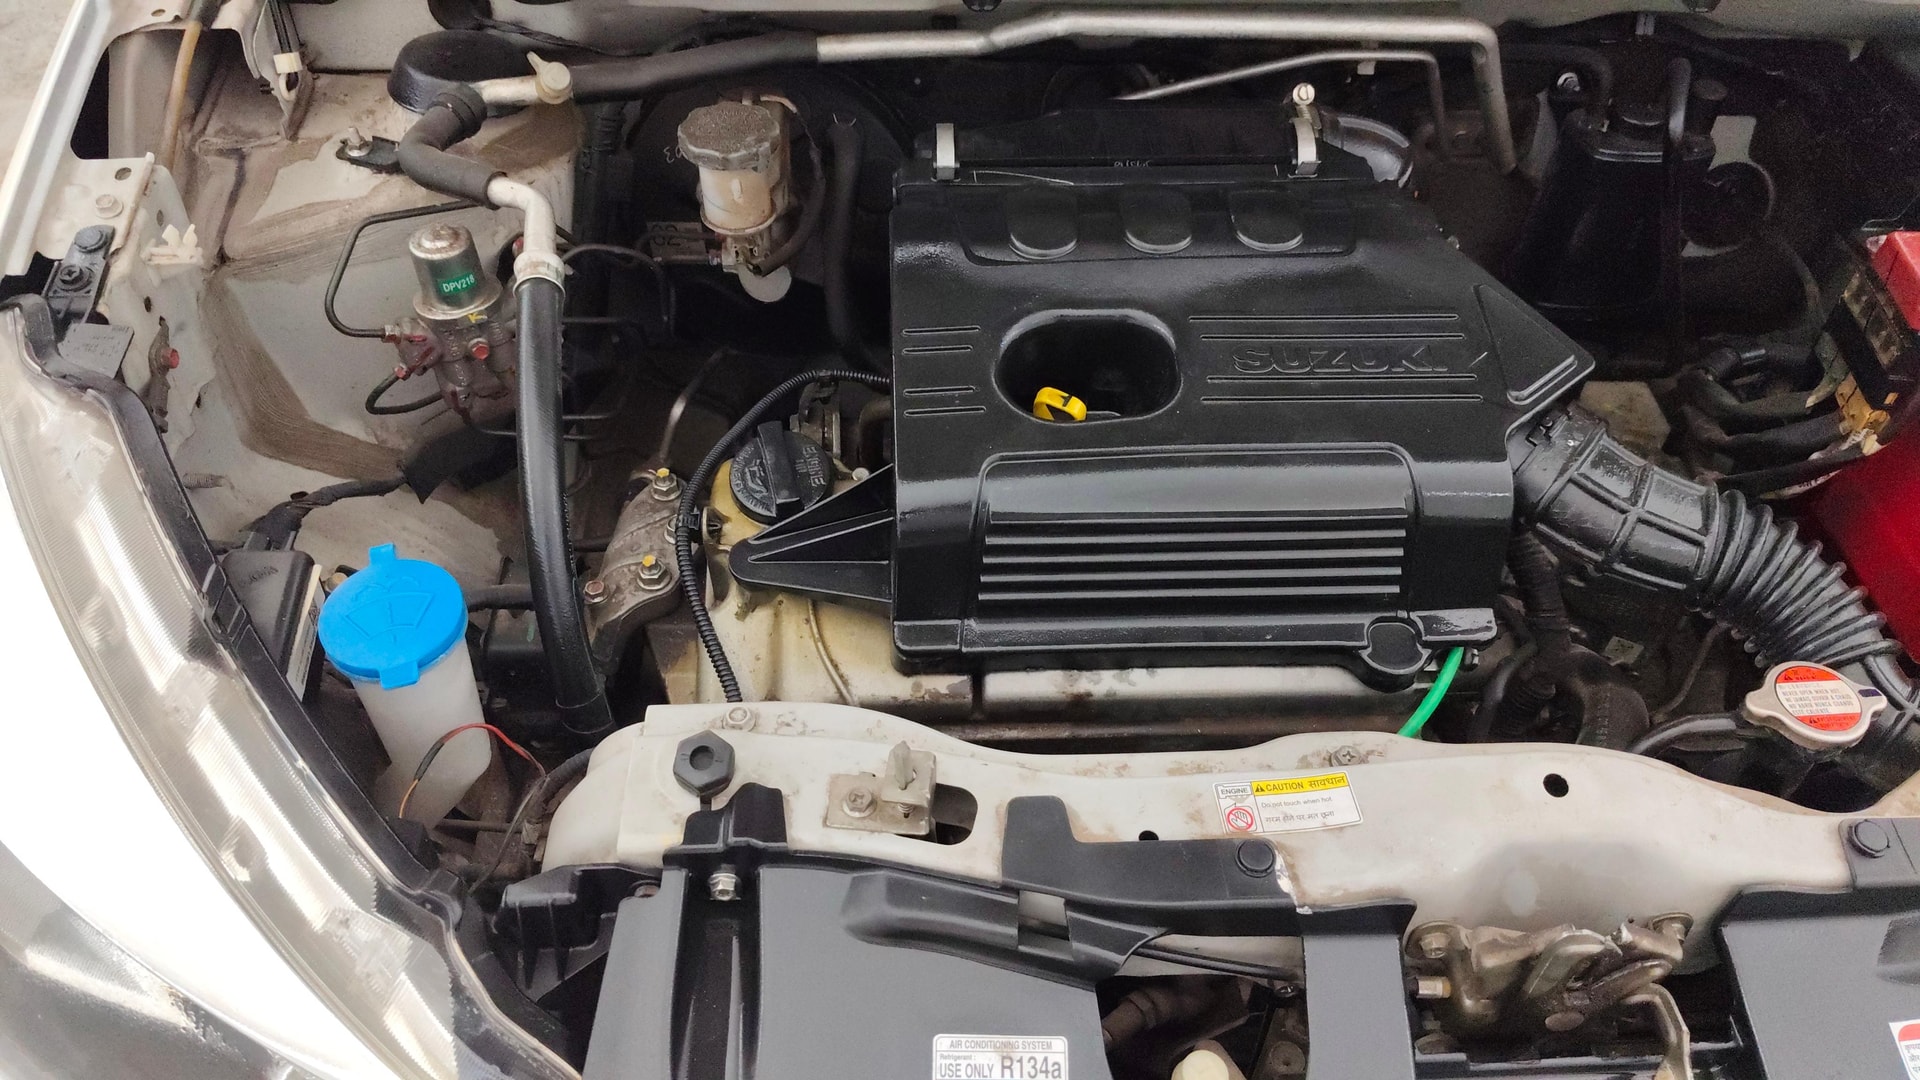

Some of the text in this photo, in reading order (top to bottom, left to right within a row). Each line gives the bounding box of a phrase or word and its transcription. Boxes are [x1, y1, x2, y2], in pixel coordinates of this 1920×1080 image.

[442, 274, 475, 292] DPV218
[1231, 345, 1449, 373] SUZUKI
[1266, 781, 1304, 792] CAUTION
[1308, 776, 1345, 789] सावधान
[1221, 787, 1248, 795] ENGINE
[949, 1040, 1053, 1050] AIR CONDITIONING SYSTEM
[940, 1055, 1062, 1079] USE ONLY R134a
